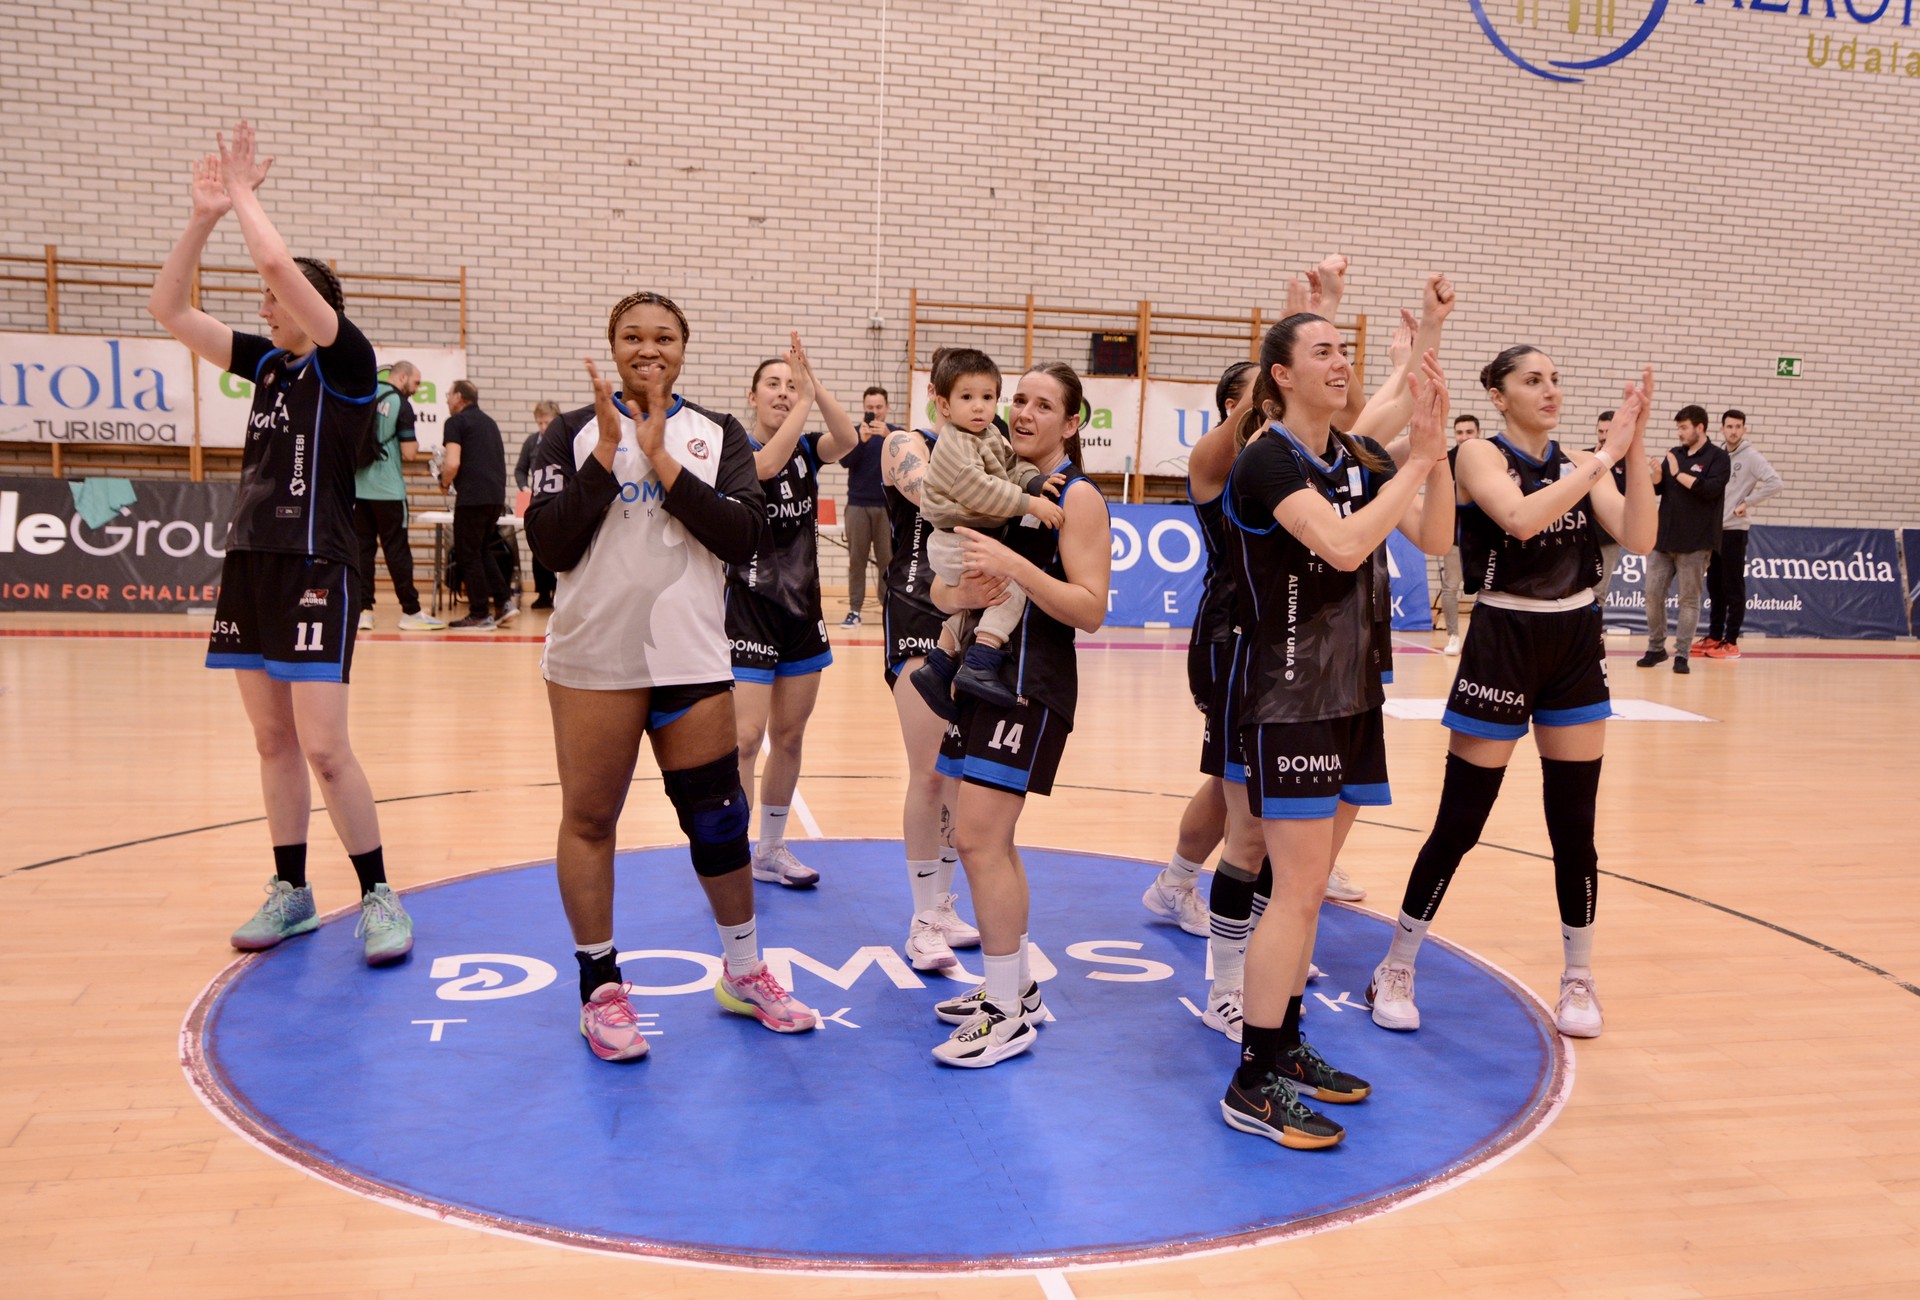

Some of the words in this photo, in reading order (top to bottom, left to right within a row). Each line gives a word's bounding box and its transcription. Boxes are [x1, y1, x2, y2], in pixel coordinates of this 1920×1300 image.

[0, 340, 174, 412] rola
[294, 434, 305, 477] CORTEBI
[0, 491, 232, 558] leGrou
[907, 559, 918, 583] URIA
[1743, 552, 1895, 582] armendia
[3, 583, 50, 599] ION
[62, 584, 109, 600] FOR
[1288, 574, 1298, 624] ALTUNA
[1745, 594, 1802, 611] okatuak
[212, 621, 240, 635] USA
[294, 622, 324, 651] 11
[1287, 626, 1296, 634] Y
[899, 636, 939, 650] DOMU
[1286, 636, 1295, 667] URIA
[1458, 678, 1525, 707] DOMUSA
[987, 719, 1025, 754] 14
[1277, 753, 1342, 772] DOMUA
[429, 938, 1328, 1001] DOMUS
